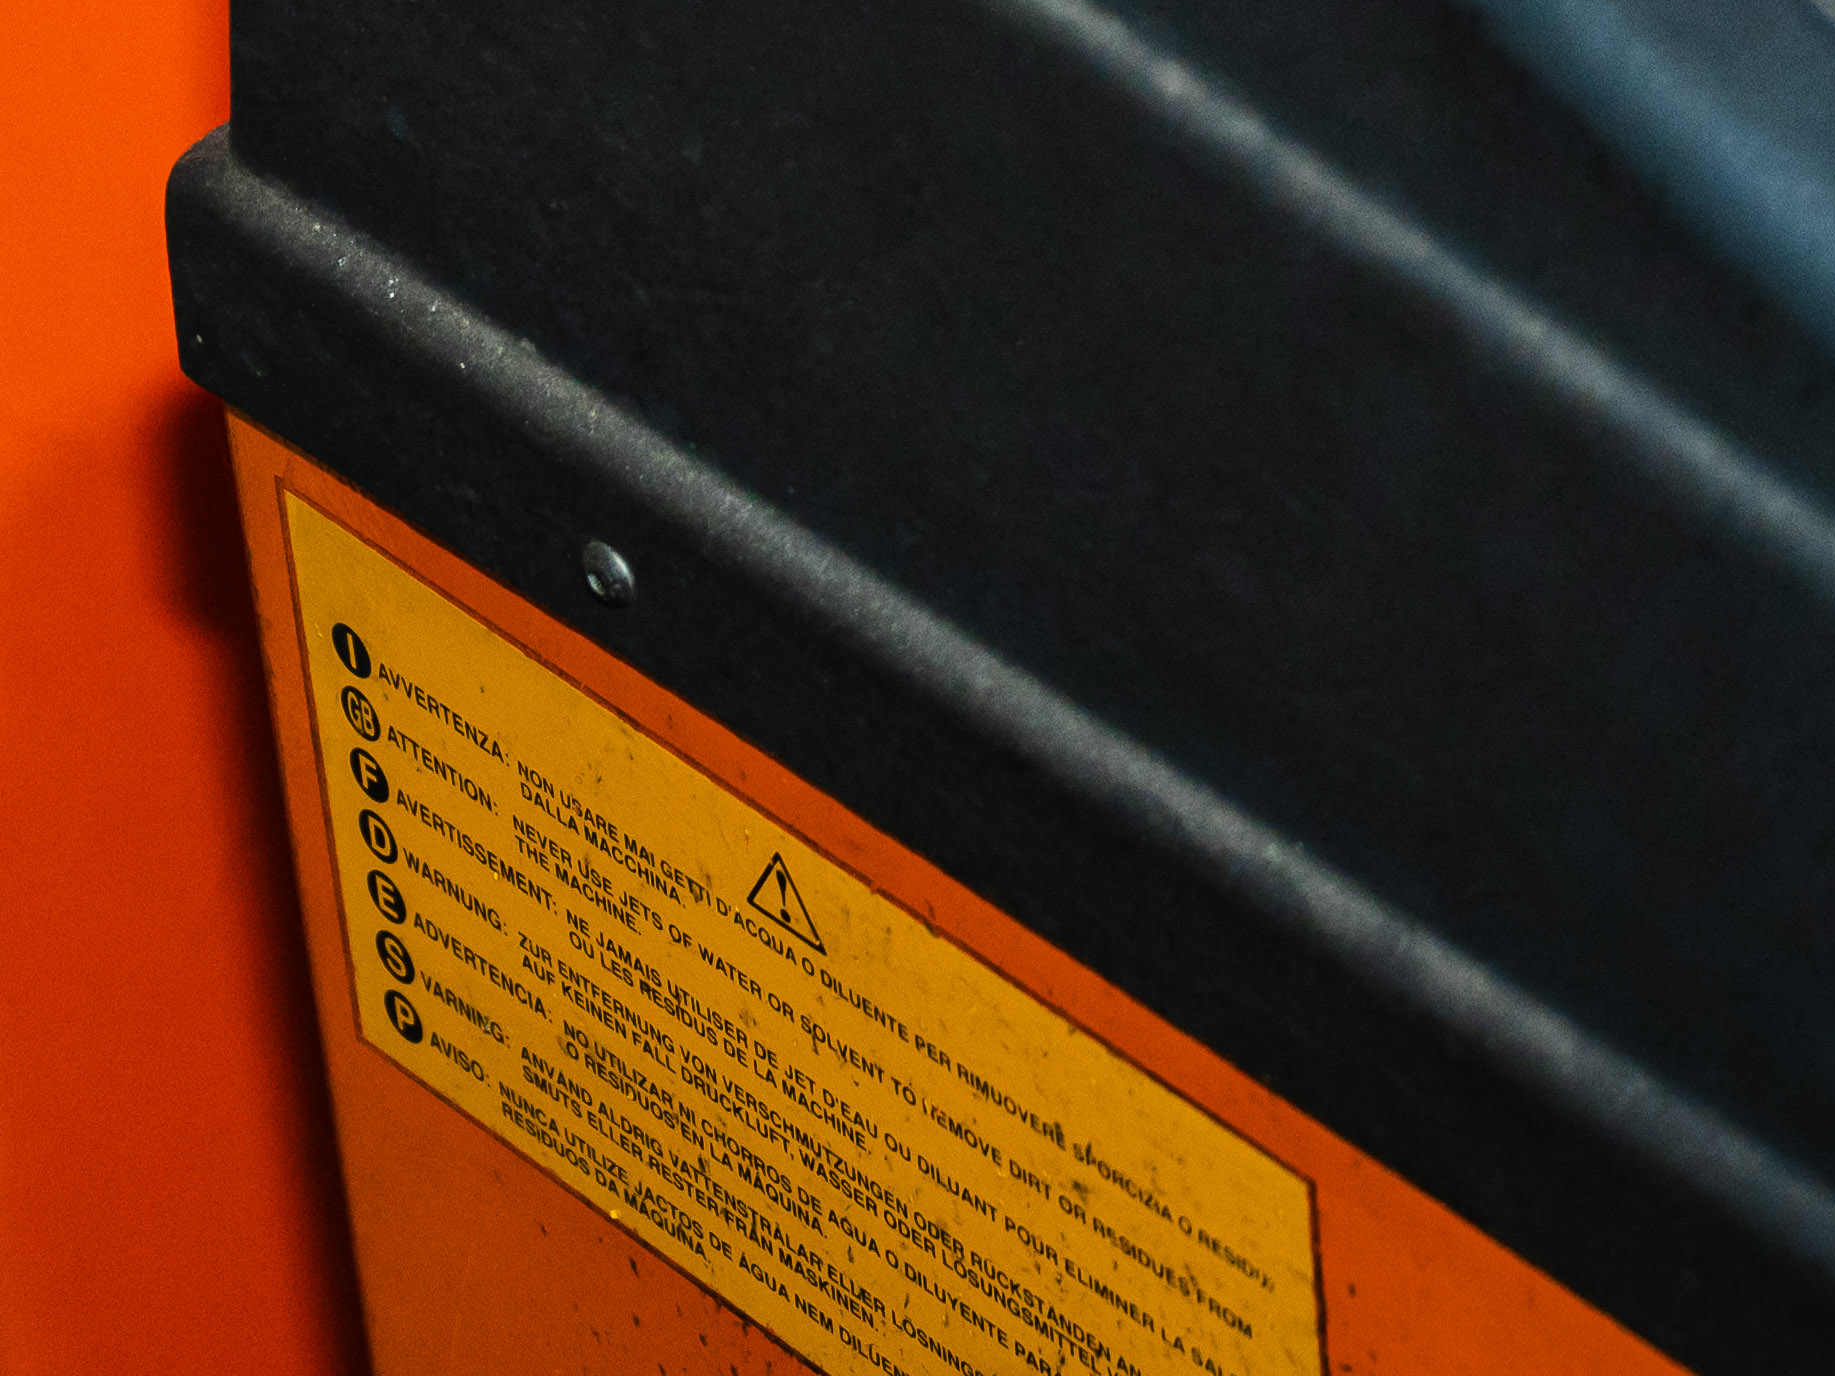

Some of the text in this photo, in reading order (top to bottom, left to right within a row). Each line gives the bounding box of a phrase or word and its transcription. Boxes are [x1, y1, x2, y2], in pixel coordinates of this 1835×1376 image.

[377, 661, 511, 768] AVVERTENZA:
[516, 759, 556, 800] NON
[558, 789, 621, 845] USARE
[622, 832, 657, 869] MAI
[659, 858, 713, 908] GETTI
[714, 895, 798, 967] D'ACQUA
[800, 955, 816, 978] O
[818, 967, 910, 1044] DILUENTE
[913, 1033, 953, 1073] PER
[386, 724, 500, 818] ATTENTION:
[511, 813, 574, 870] NEVER
[576, 858, 615, 899] USE
[618, 889, 665, 932] JETS
[667, 922, 693, 950] OF
[696, 942, 763, 1002] WATER
[766, 991, 796, 1025] OR
[799, 1013, 886, 1085] SOLVENT
[889, 1075, 918, 1108] TO
[1008, 1158, 1052, 1202] DIRT
[1057, 1194, 1088, 1226] OR
[513, 833, 643, 937] THE MACHINE.
[519, 780, 687, 909] DALLA MACCHINA.
[395, 787, 559, 917] AVERTISSEMENT:
[565, 907, 592, 940] NE
[594, 930, 664, 989] JAMAIS
[666, 978, 750, 1051] UTILISER
[752, 1039, 780, 1071] DE
[783, 1063, 817, 1096] JET
[821, 1087, 879, 1140] D'EAU
[883, 1131, 913, 1163] OU
[916, 1153, 998, 1223] DILUANT
[1003, 1214, 1060, 1268] POUR
[1063, 1257, 1156, 1334] ELIMINER
[1159, 1326, 1187, 1355] LA
[401, 846, 509, 937] WARNUNG:
[516, 930, 554, 969] ZUR
[556, 958, 677, 1056] ENTFERNUNG
[678, 1044, 719, 1086] VON
[721, 1073, 910, 1221] VERSCHMUTZUNGEN
[912, 1210, 966, 1261] ODER
[412, 911, 554, 1025] ADVERTENCIA:
[562, 1018, 591, 1051] NO
[592, 1040, 675, 1112] UTILIZAR
[677, 1100, 698, 1129] NI
[700, 1117, 794, 1195] CHORROS
[796, 1184, 824, 1217] DE
[903, 1260, 1010, 1350] DILUYENTE
[1013, 1339, 1065, 1376] PAR
[419, 969, 512, 1050] VARNING:
[596, 1100, 665, 1160] ALDRIG
[826, 1262, 887, 1320] ELLER
[521, 953, 557, 986] AUF
[560, 979, 628, 1041] KEINEN
[630, 1029, 678, 1076] FALL
[679, 1063, 796, 1162] DRUCKLUFT,
[797, 1147, 879, 1218] WASSER
[882, 1208, 938, 1260] ODER
[564, 1040, 581, 1062] O
[679, 1119, 706, 1152] EN
[708, 1141, 735, 1173] LA
[567, 929, 596, 961] OU
[598, 950, 636, 989] LES
[722, 1036, 750, 1069] DE
[752, 1058, 779, 1090] LA
[429, 1030, 492, 1089] AVISO:
[497, 1080, 562, 1138] NUNCA
[562, 1126, 631, 1189] UTILIZE
[633, 1179, 705, 1241] JACTOS
[707, 1230, 734, 1263] DE
[793, 1292, 835, 1336] NEM
[838, 1324, 910, 1376] DILUEN
[521, 1063, 584, 1120] SMUTS
[585, 1109, 645, 1164] ELLER
[646, 1152, 721, 1218] RESTER
[777, 1246, 880, 1333] MASKINEN.
[593, 1166, 622, 1199] DA
